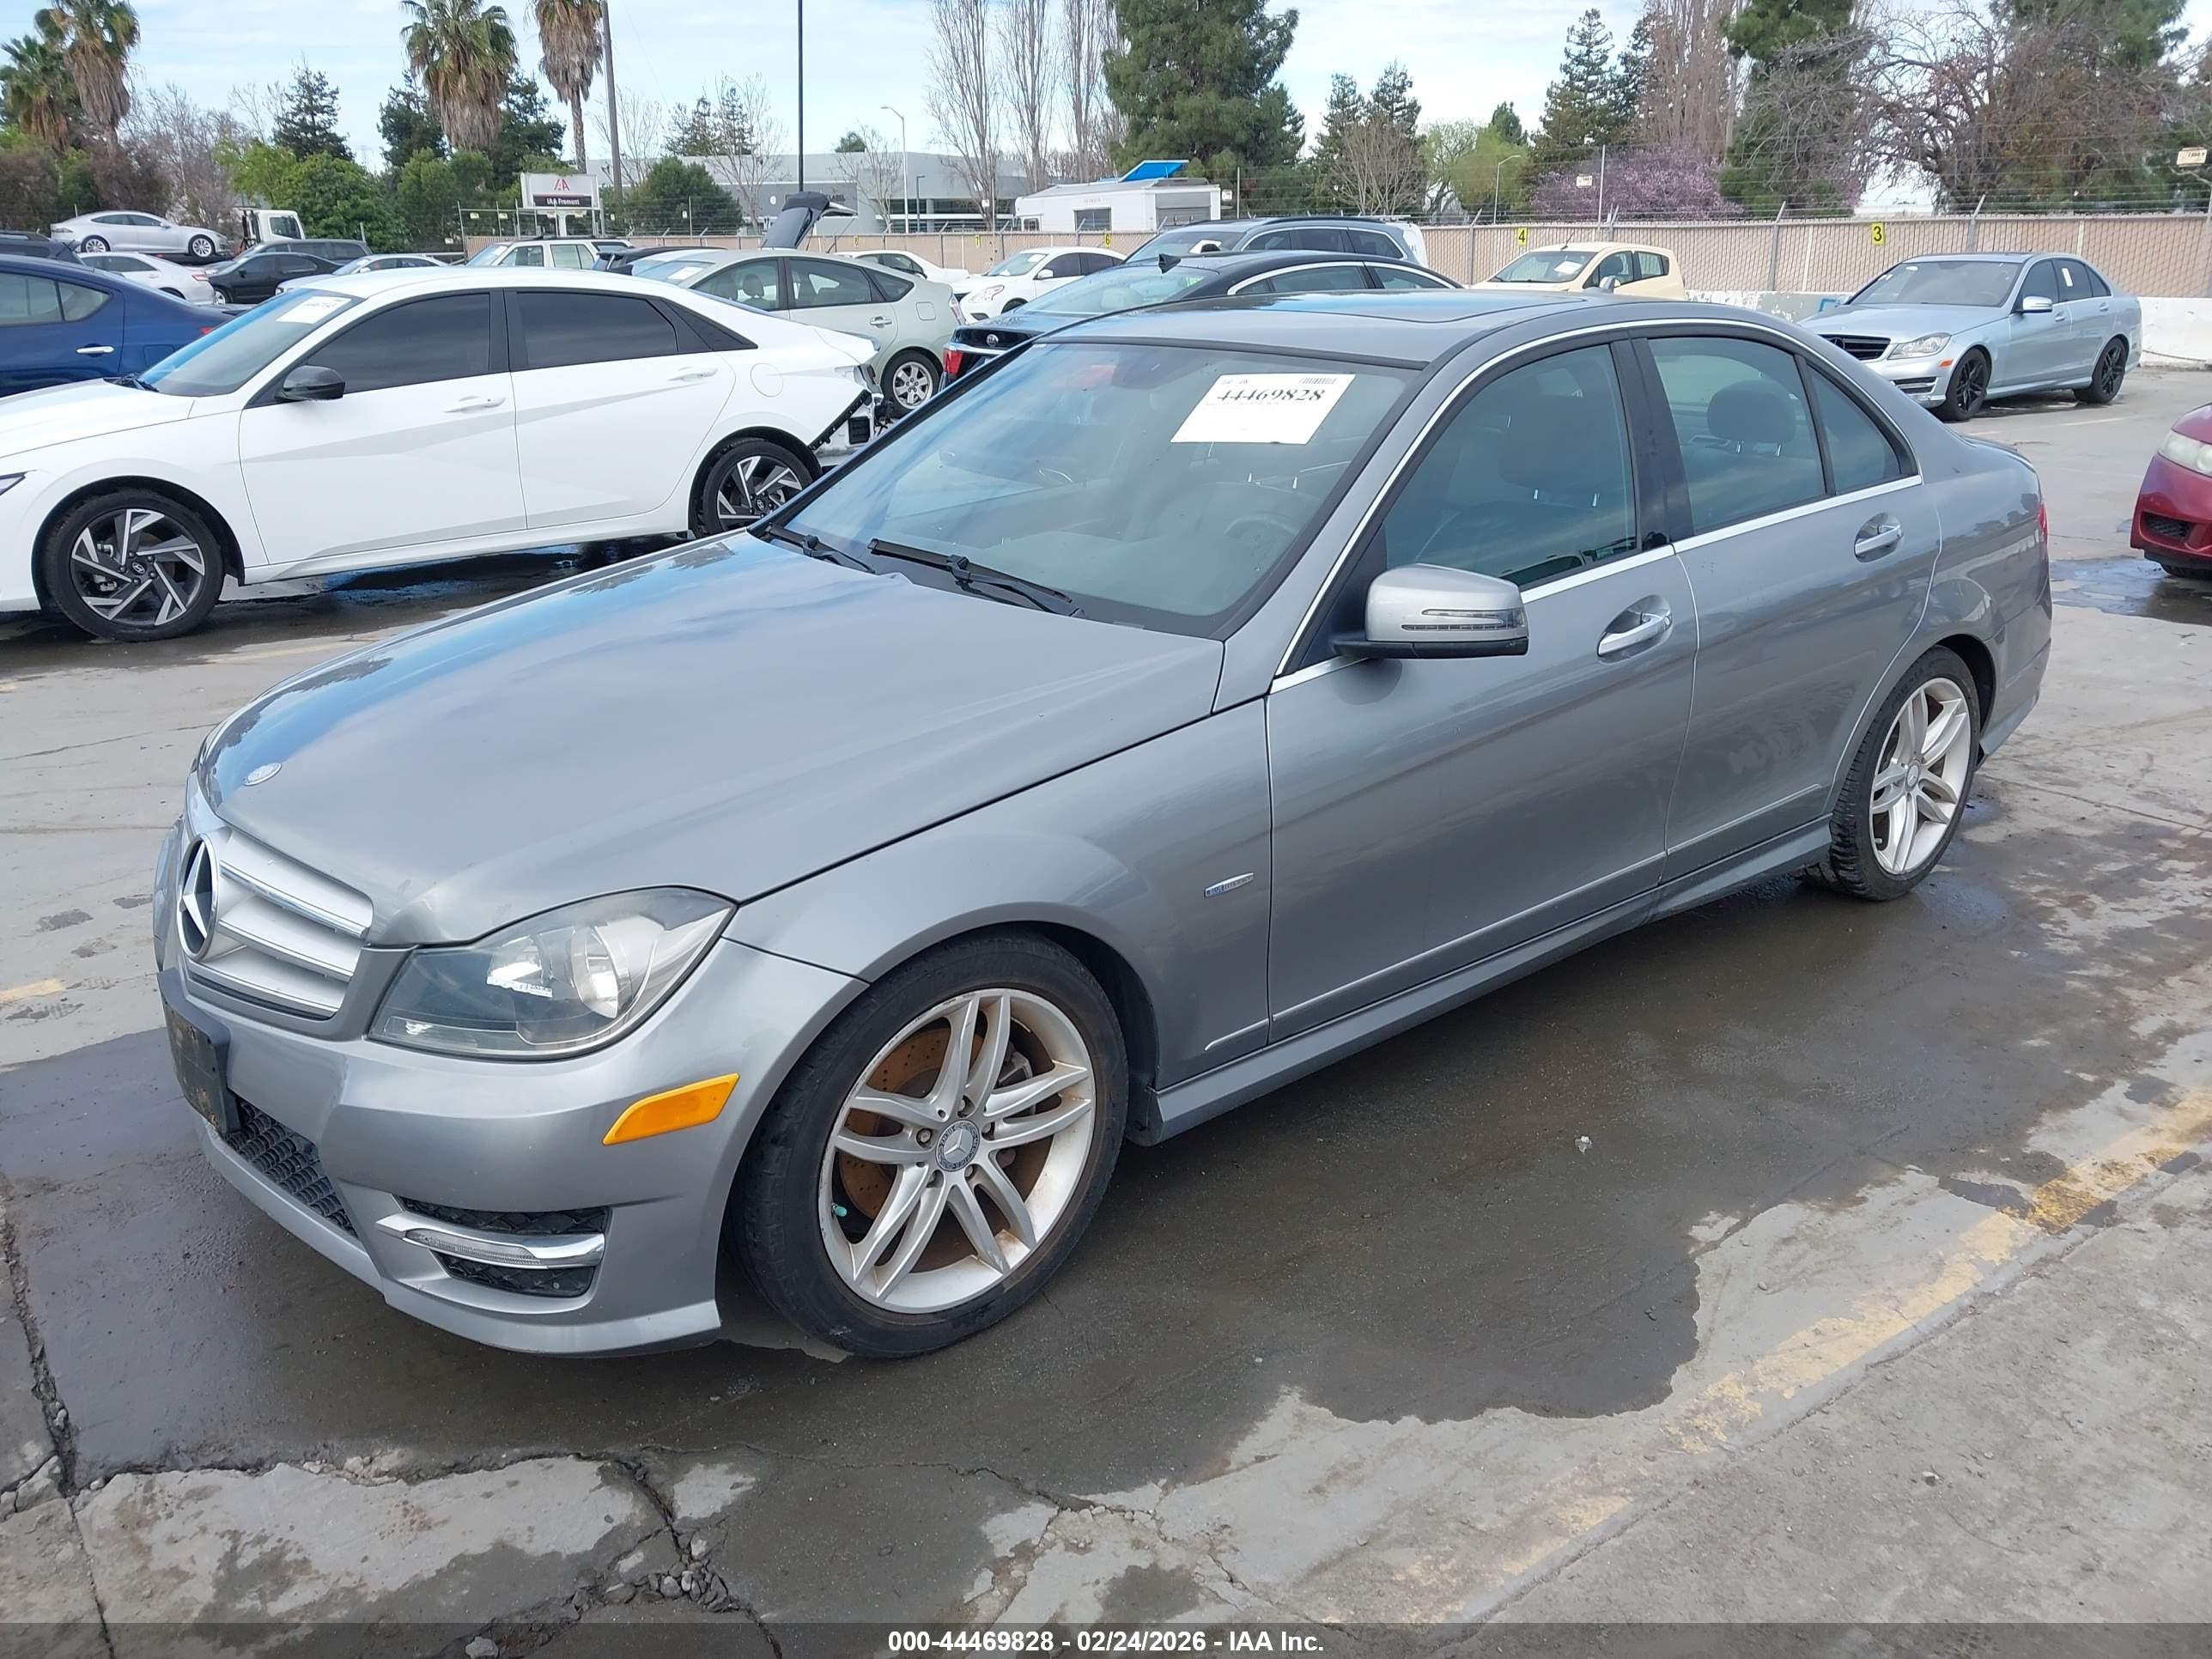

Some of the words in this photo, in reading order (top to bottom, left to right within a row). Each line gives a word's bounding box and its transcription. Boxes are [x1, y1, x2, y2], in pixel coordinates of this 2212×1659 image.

[1105, 234, 1110, 246] 6
[1518, 229, 1526, 243] 4
[1874, 226, 1882, 241] 3
[1217, 388, 1325, 401] 44469828
